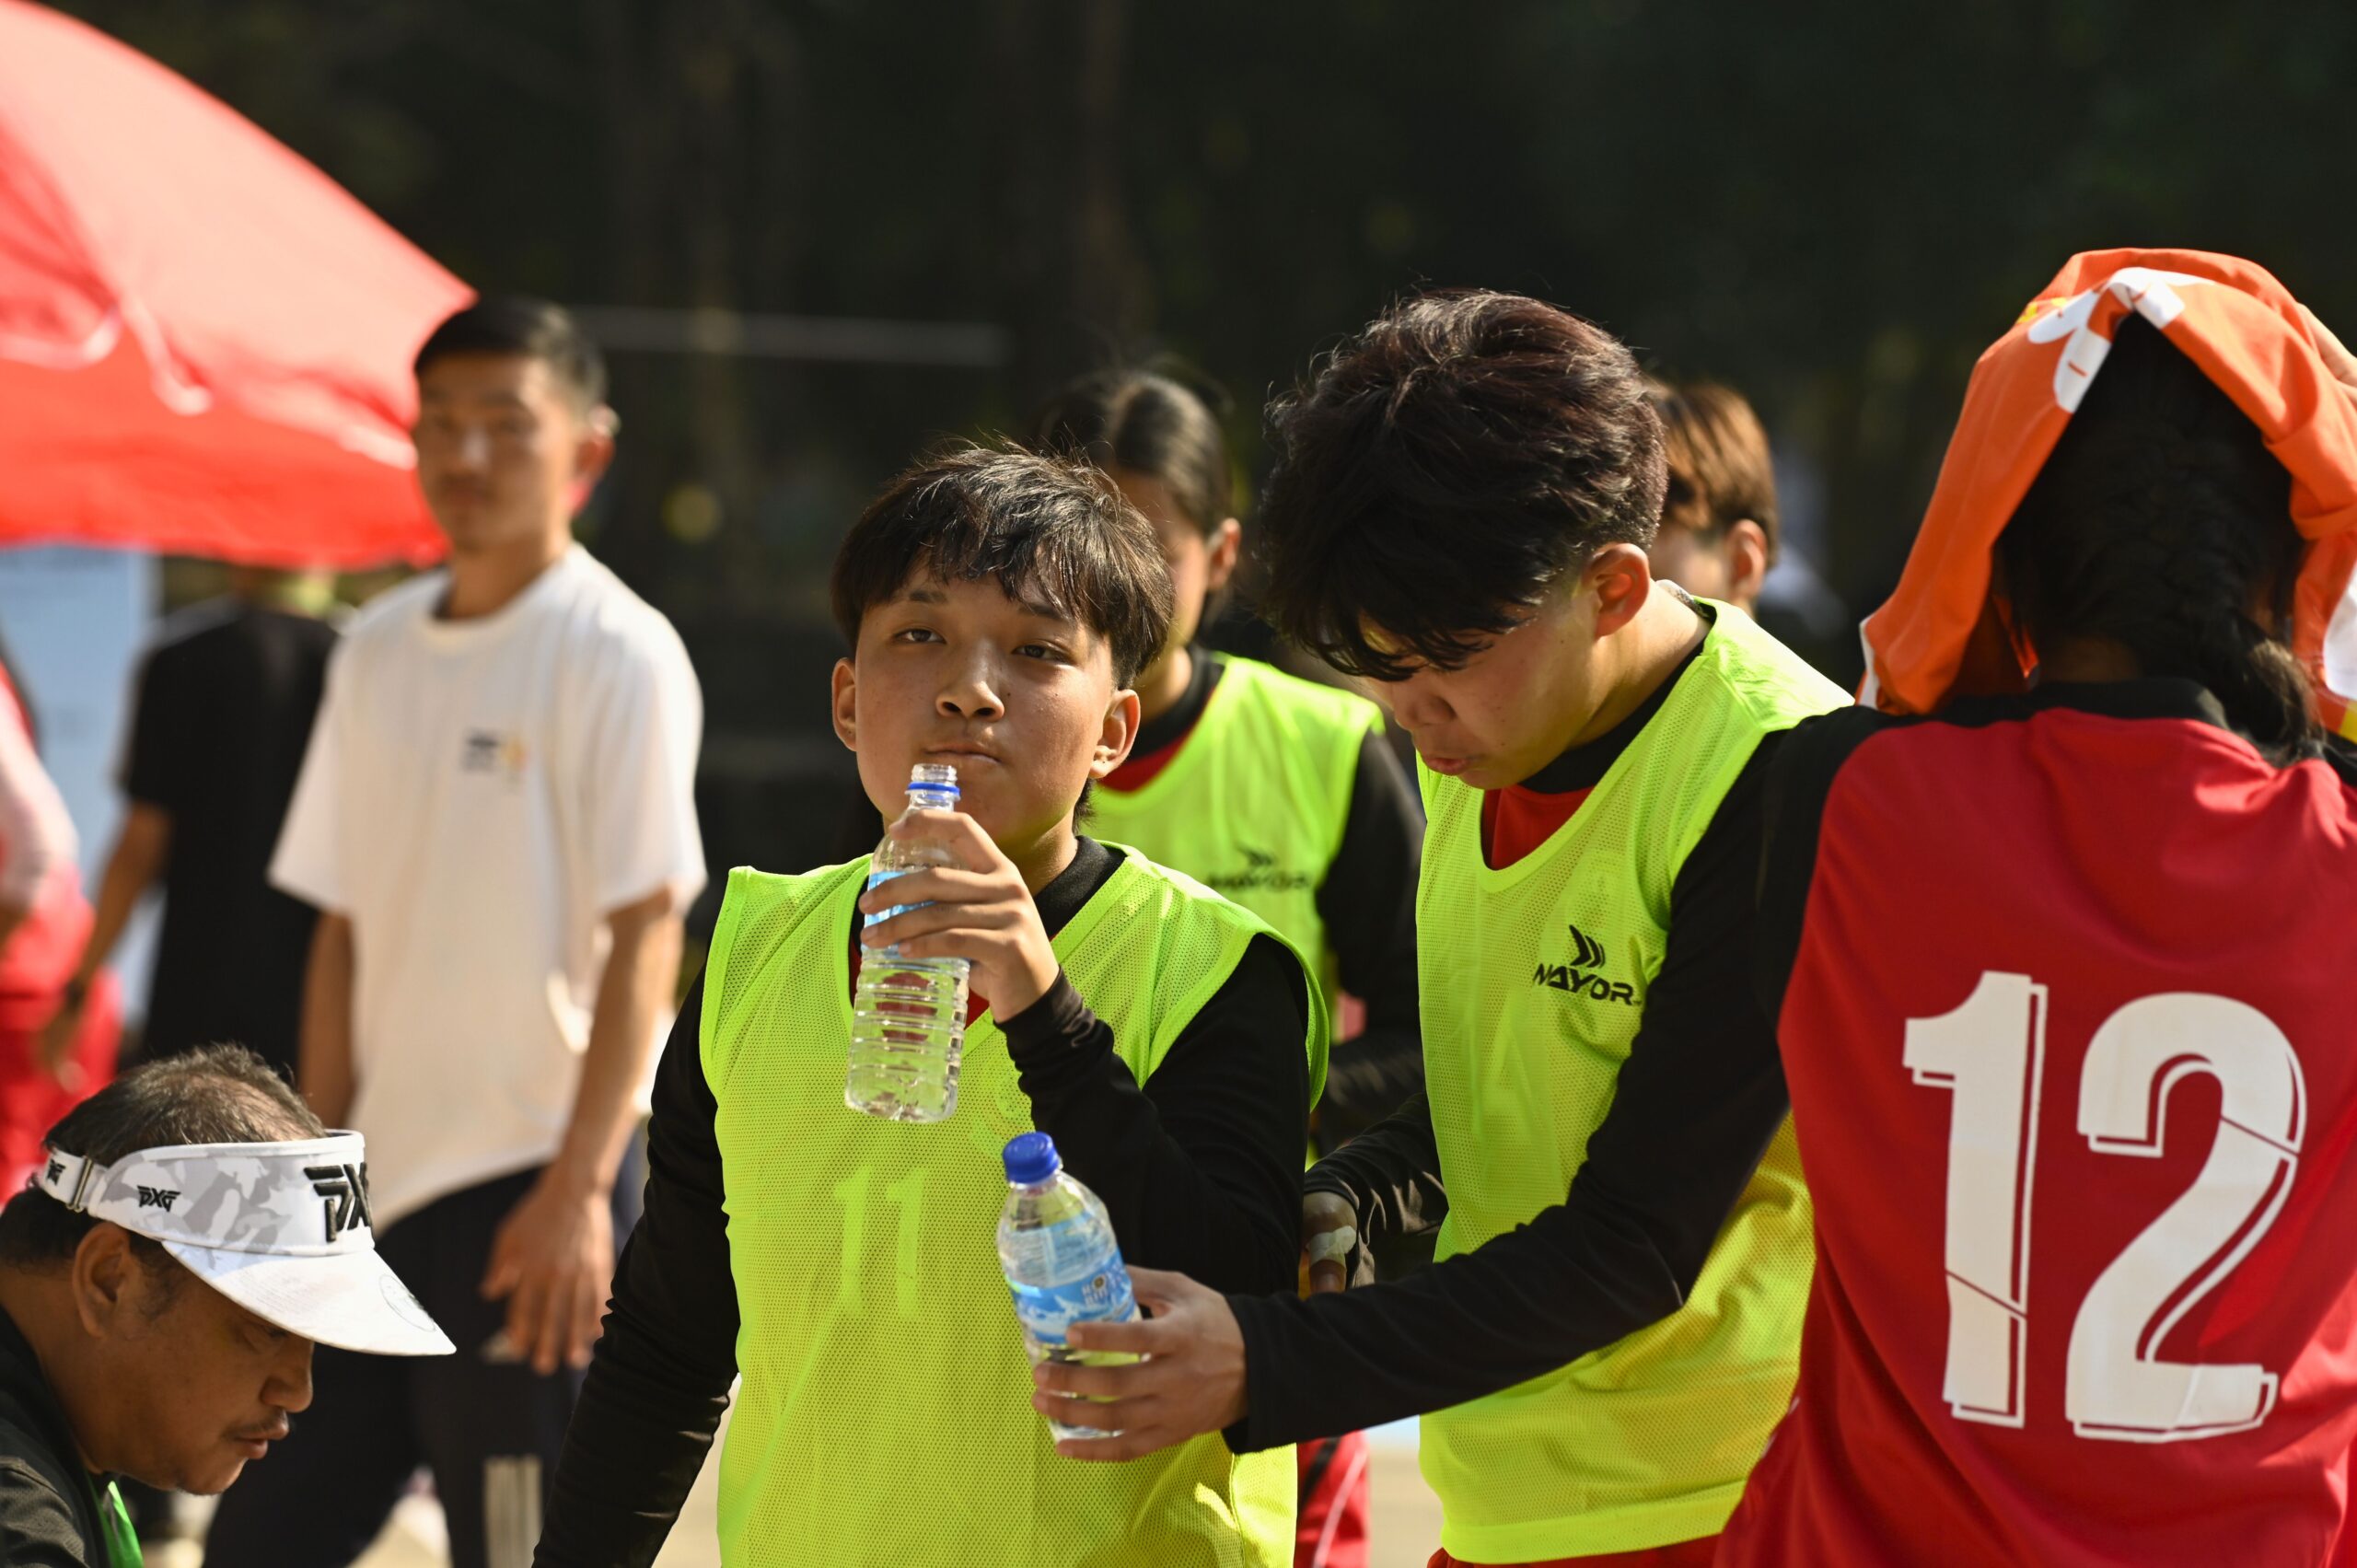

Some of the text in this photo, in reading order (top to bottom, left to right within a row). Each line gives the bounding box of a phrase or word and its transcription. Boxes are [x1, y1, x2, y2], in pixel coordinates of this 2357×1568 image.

[136, 1185, 181, 1213] PXG
[303, 1162, 374, 1242] PX
[832, 1165, 928, 1320] 11
[1903, 970, 2306, 1442] 12
